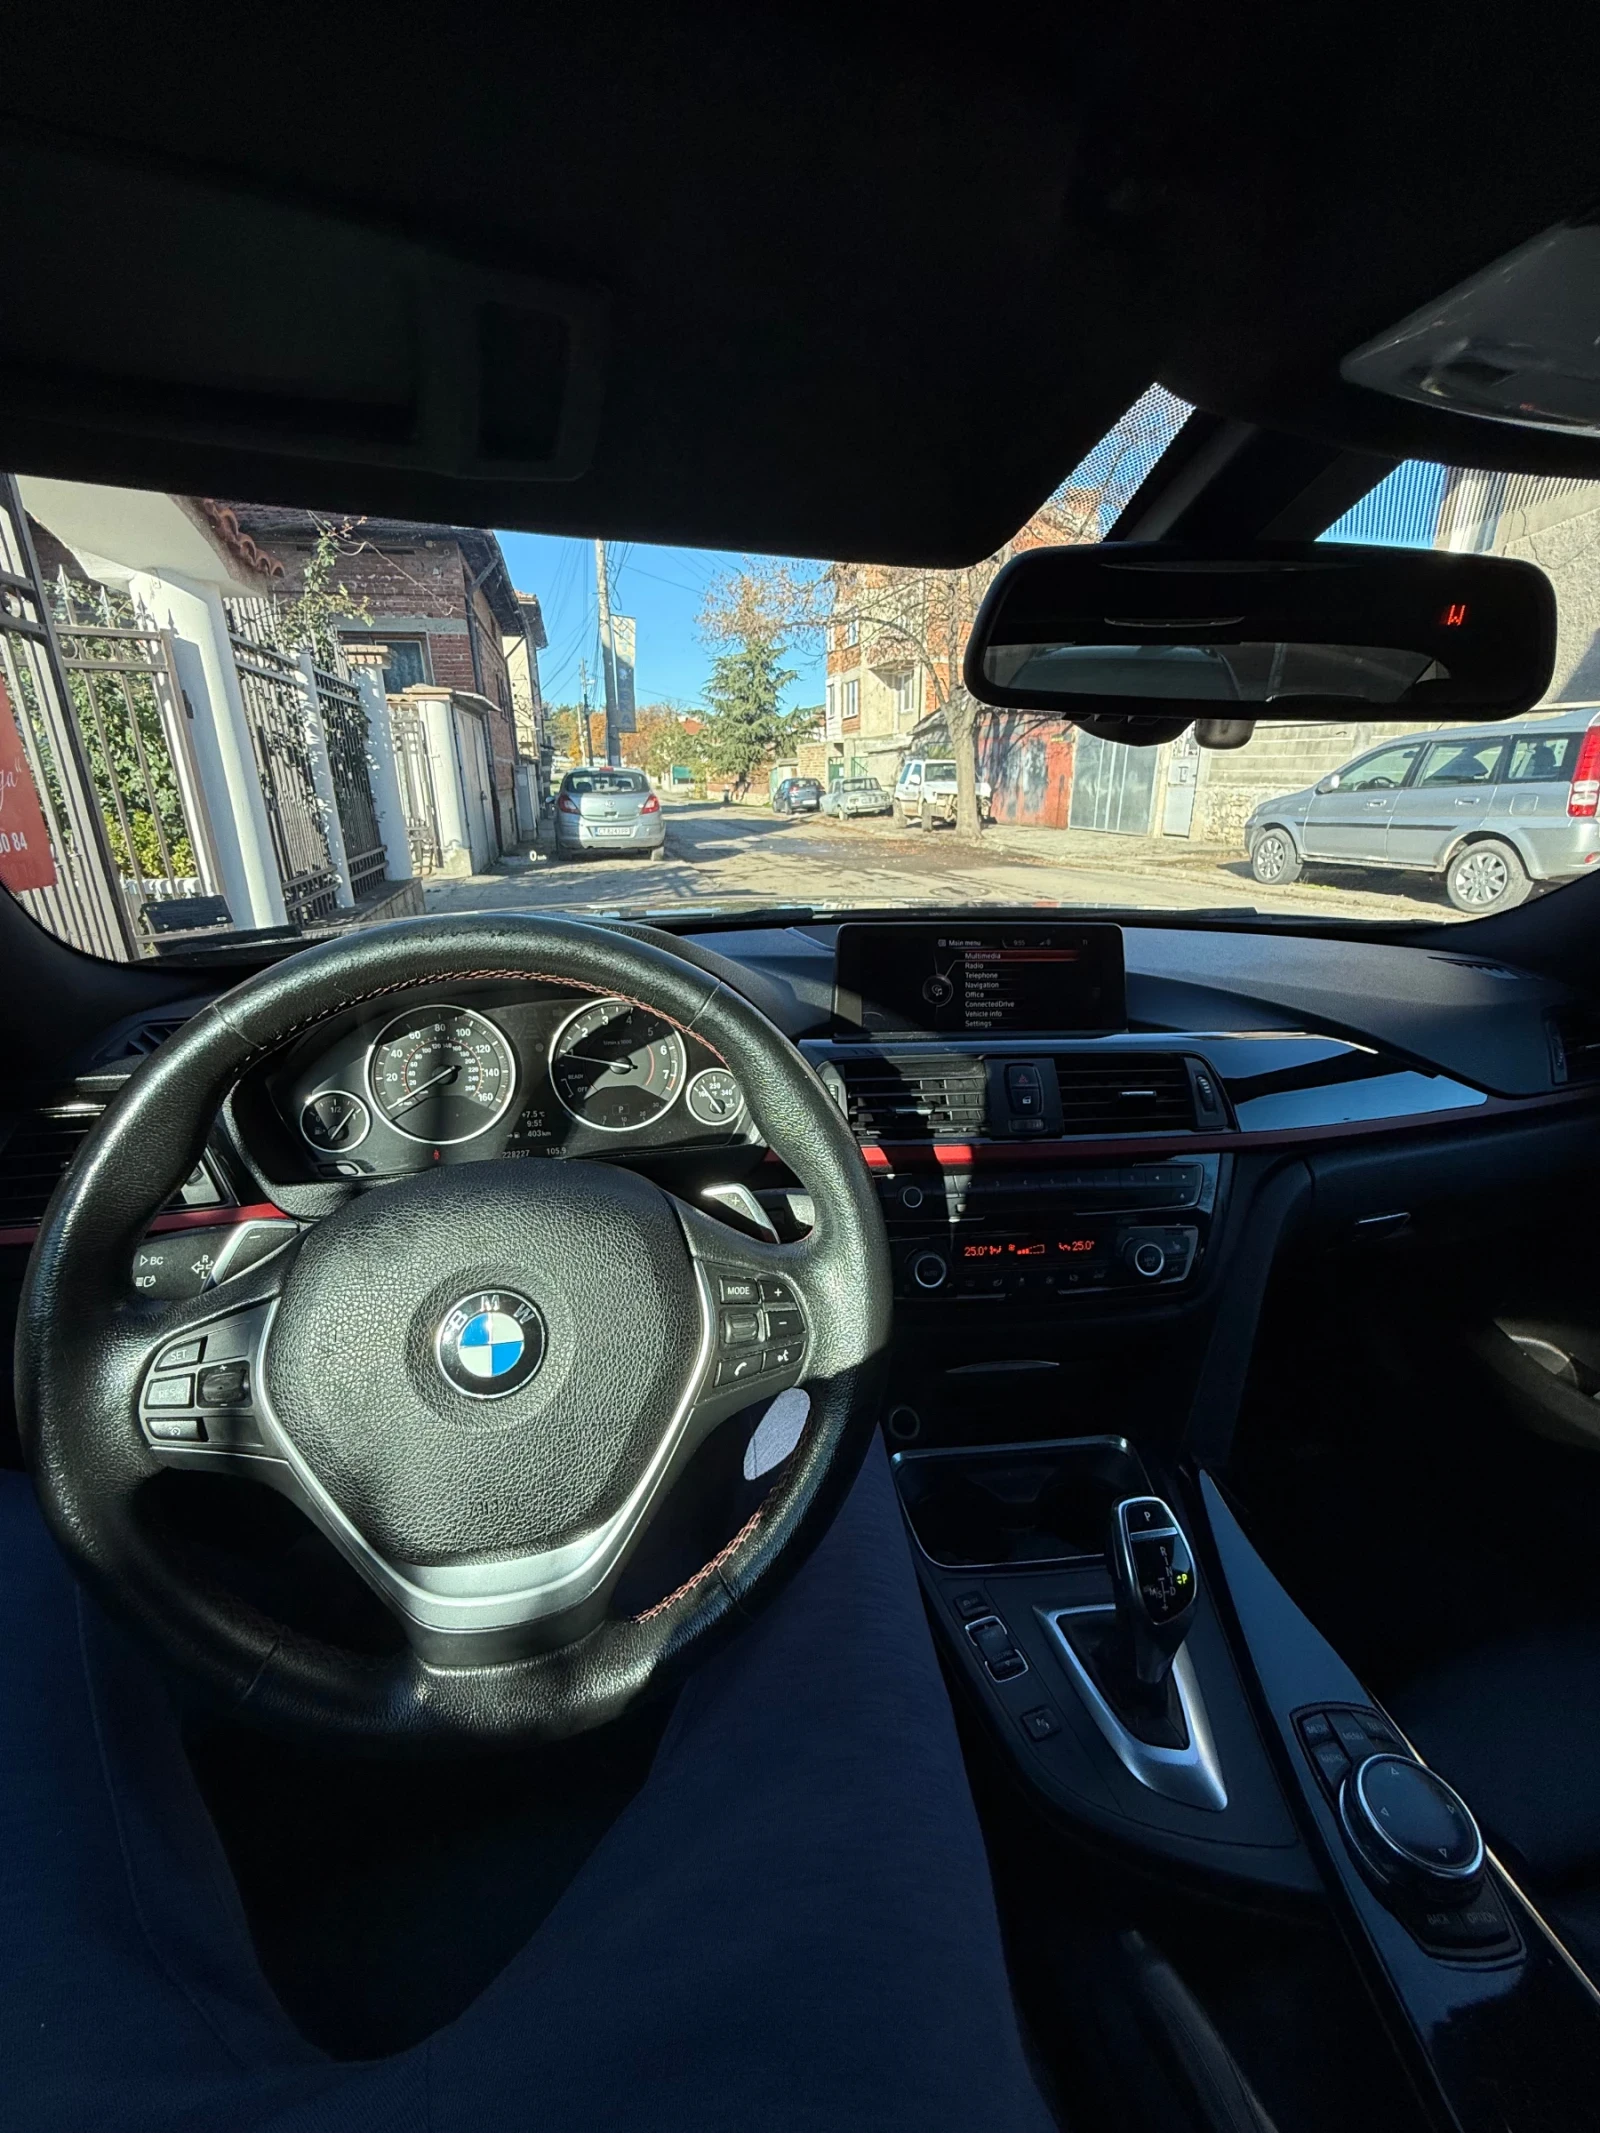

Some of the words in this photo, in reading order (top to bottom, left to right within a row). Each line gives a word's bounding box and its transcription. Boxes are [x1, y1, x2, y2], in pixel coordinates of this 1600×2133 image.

[12, 831, 28, 852] 84
[948, 939, 964, 947] Main
[964, 952, 1002, 960] Multimedia
[964, 962, 984, 970] Radio
[964, 972, 999, 980] Telephone
[964, 981, 1000, 990] Navigation
[964, 991, 985, 999] Office
[964, 1000, 1016, 1009] ConnectedDrive
[964, 1010, 989, 1018] Vehicle
[989, 1010, 1003, 1018] info
[601, 1015, 609, 1025] 3
[964, 1019, 992, 1029] Settings
[434, 1023, 446, 1032] 80
[455, 1028, 472, 1037] 100
[581, 1027, 589, 1038] 2
[474, 1044, 491, 1053] 120
[660, 1045, 667, 1055] 6
[390, 1048, 404, 1059] 40
[385, 1072, 398, 1082] 20
[484, 1068, 500, 1078] 140
[662, 1070, 669, 1080] 7
[709, 1082, 721, 1090] 250
[478, 1092, 494, 1102] 160
[330, 1106, 342, 1114] 1/2
[527, 1130, 541, 1138] 403
[150, 1256, 164, 1265] BC
[727, 1286, 750, 1295] MODE
[447, 1294, 536, 1332] BMW
[170, 1350, 187, 1361] SET
